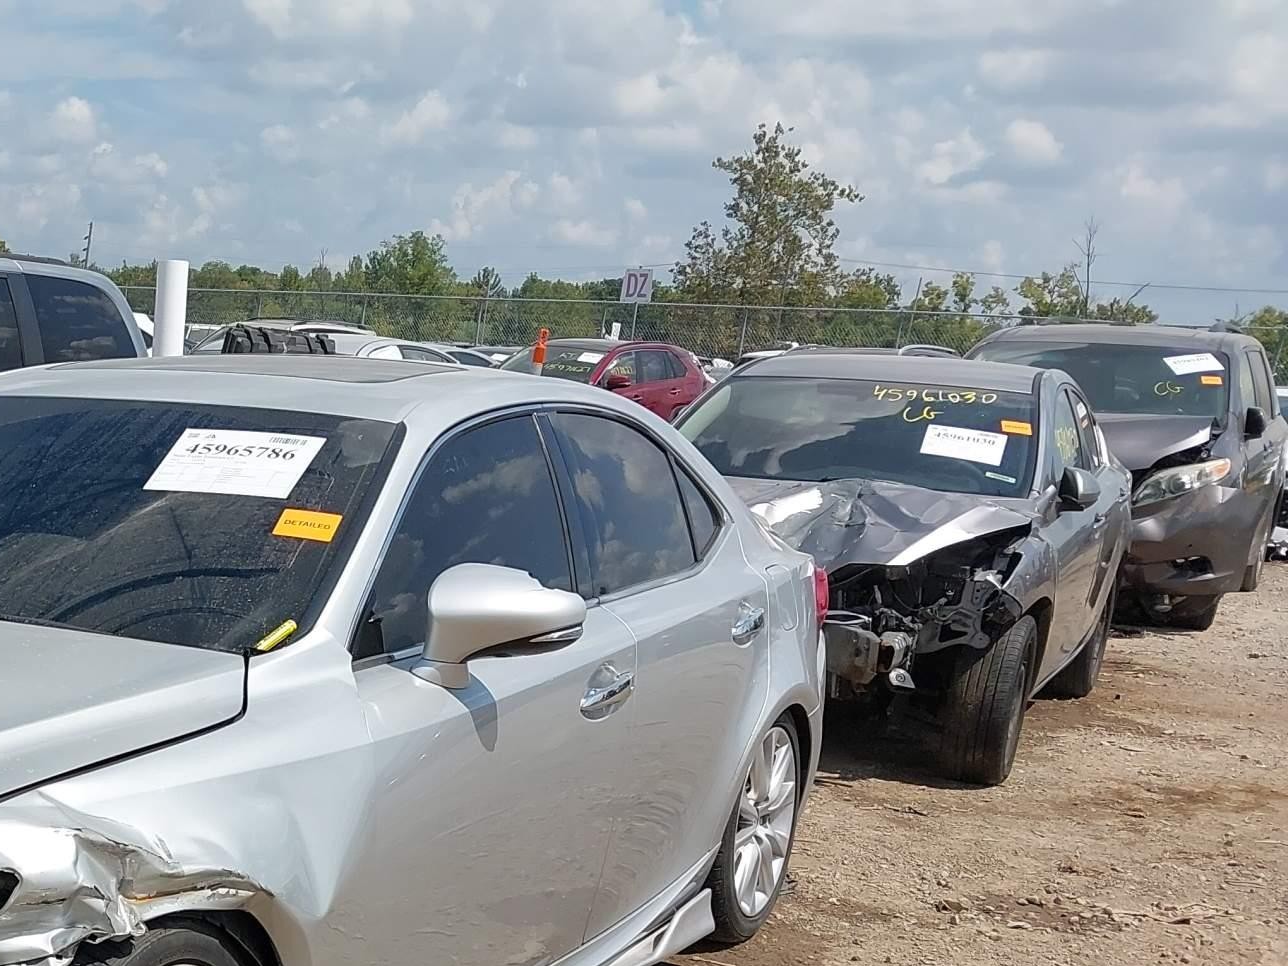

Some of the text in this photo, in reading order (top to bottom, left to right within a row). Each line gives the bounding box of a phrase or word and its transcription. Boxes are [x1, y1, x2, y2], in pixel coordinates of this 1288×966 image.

[625, 272, 649, 298] DZ
[873, 384, 998, 404] 45961030
[1154, 380, 1185, 396] CG
[903, 406, 945, 423] CG
[185, 442, 297, 462] 45965786
[283, 518, 332, 531] DETAILED
